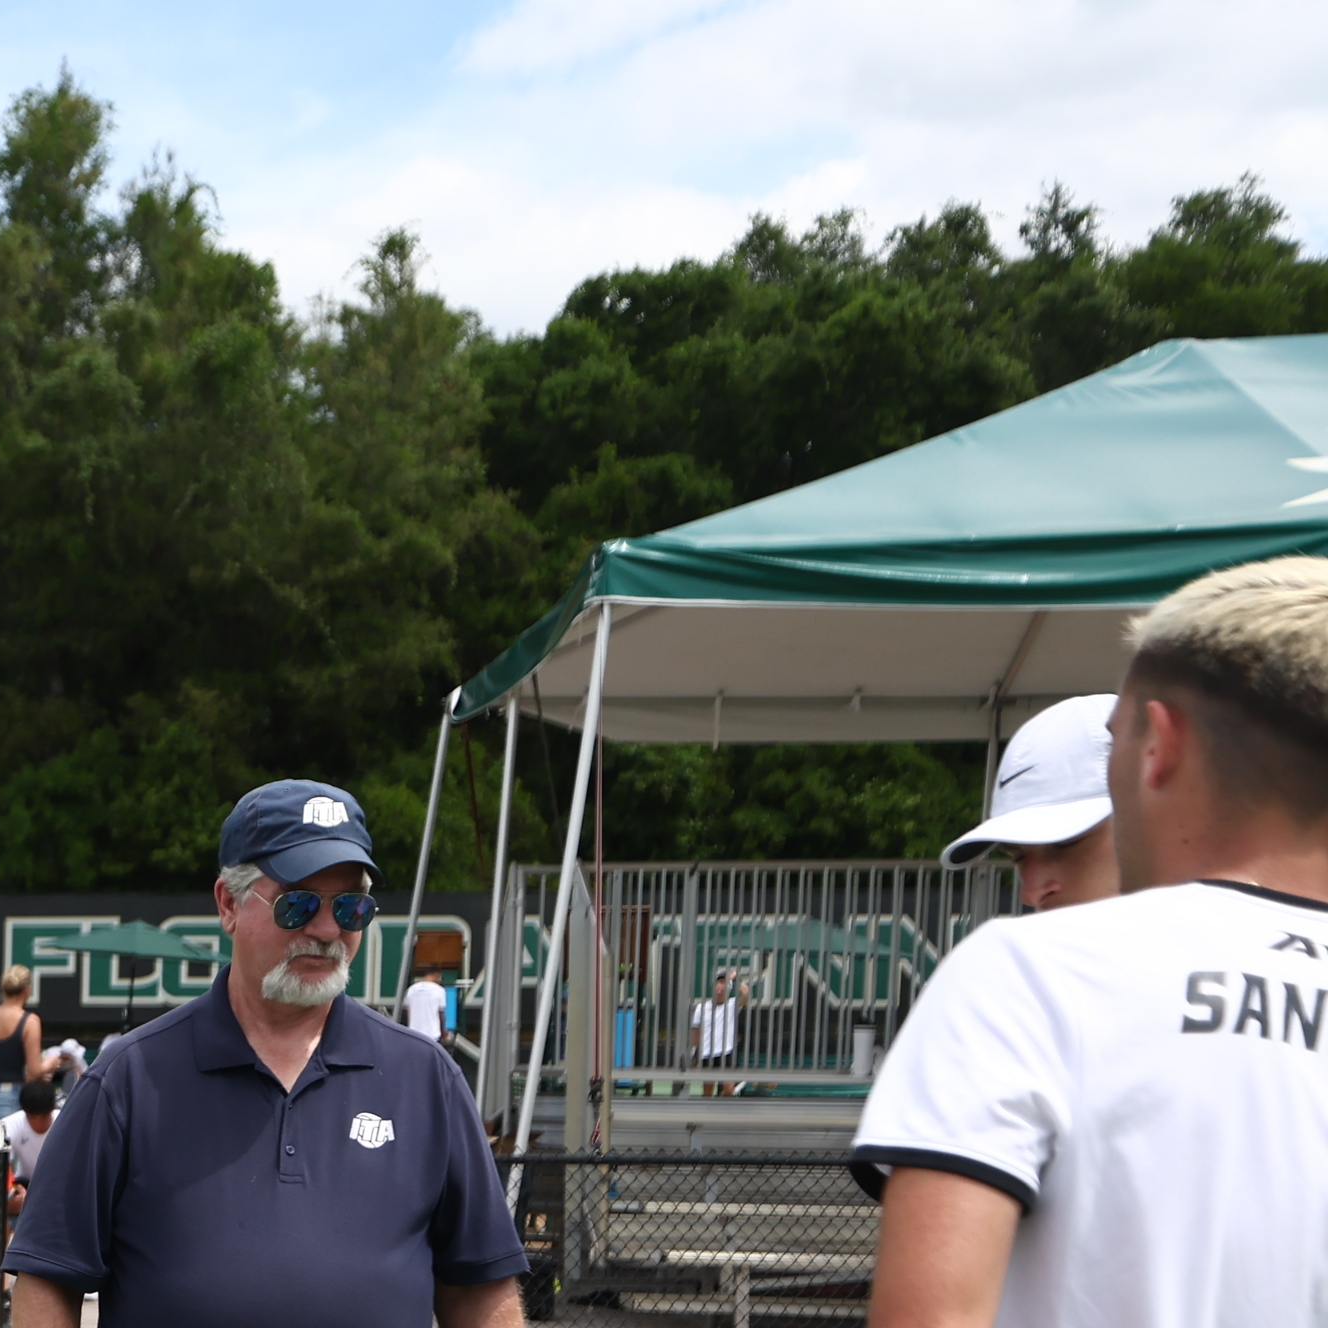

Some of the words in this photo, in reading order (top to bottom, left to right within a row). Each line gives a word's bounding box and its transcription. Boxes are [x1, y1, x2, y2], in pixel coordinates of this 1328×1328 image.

[302, 800, 349, 825] ITA
[5, 915, 566, 1007] FLOIDA
[349, 1117, 395, 1142] ITA
